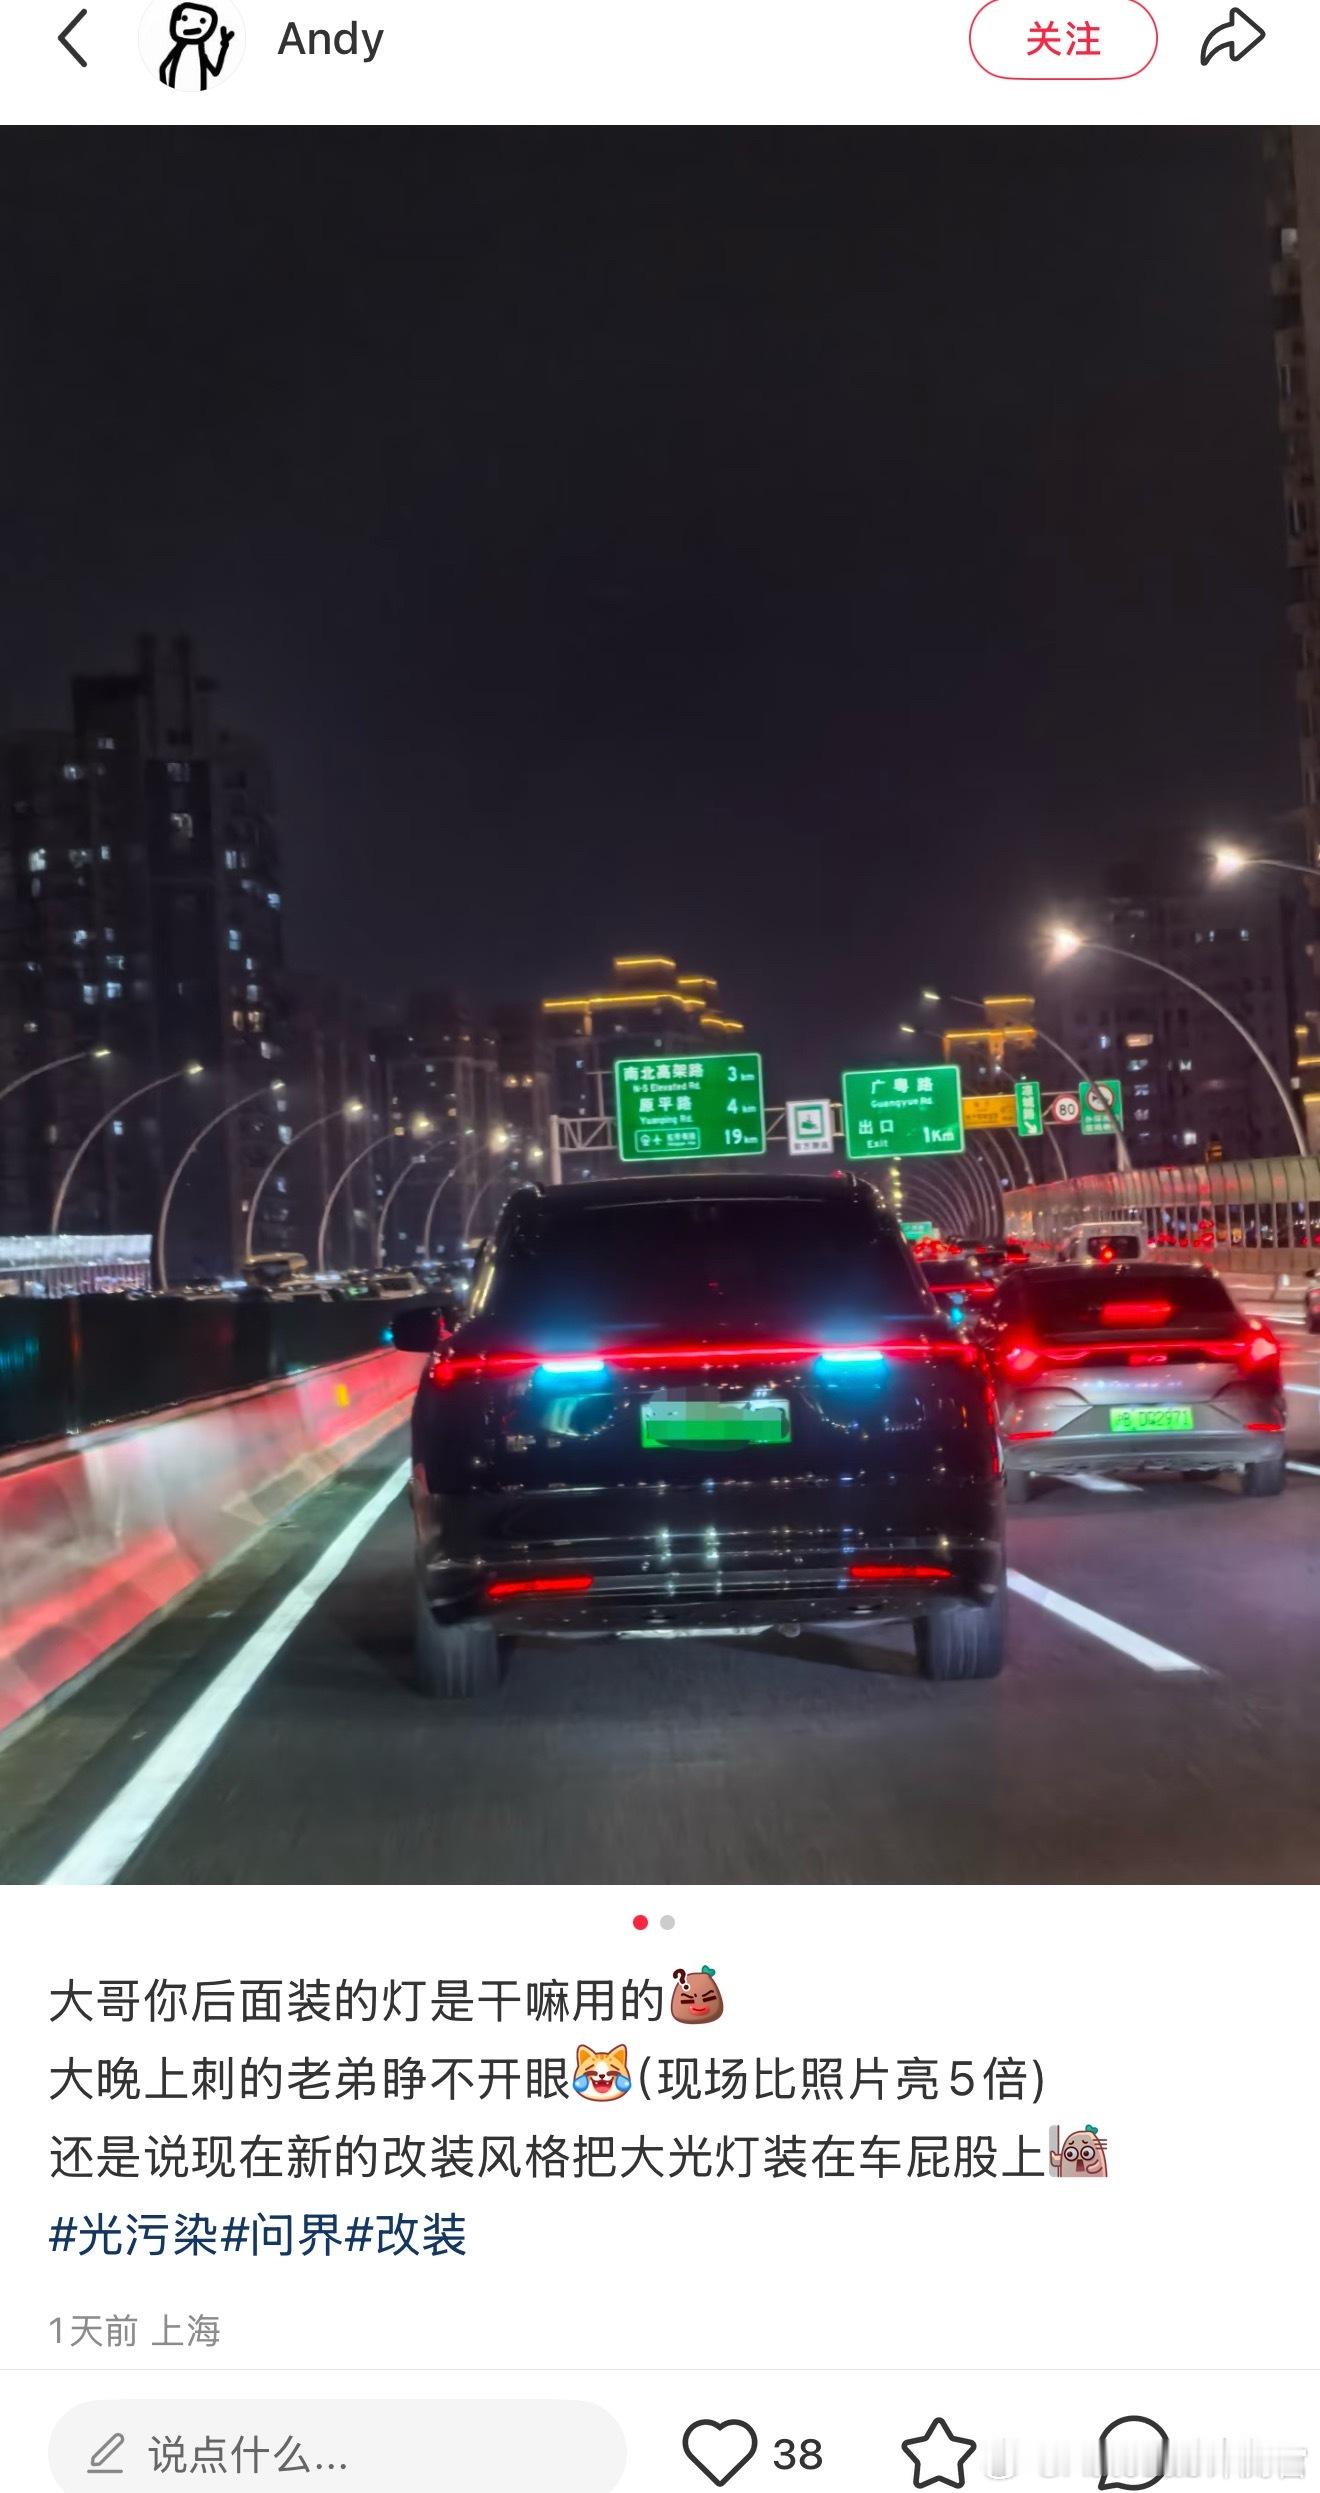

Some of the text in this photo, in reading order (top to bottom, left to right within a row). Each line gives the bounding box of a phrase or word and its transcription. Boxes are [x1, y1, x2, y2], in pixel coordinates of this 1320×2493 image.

[623, 1063, 704, 1081] 南北高架路
[727, 1066, 755, 1082] 3 km
[726, 1098, 757, 1114] 4 km
[1059, 1103, 1076, 1116] 80
[859, 1119, 894, 1135] 出口
[725, 1128, 759, 1145] 19 km
[867, 1140, 888, 1149] Exit
